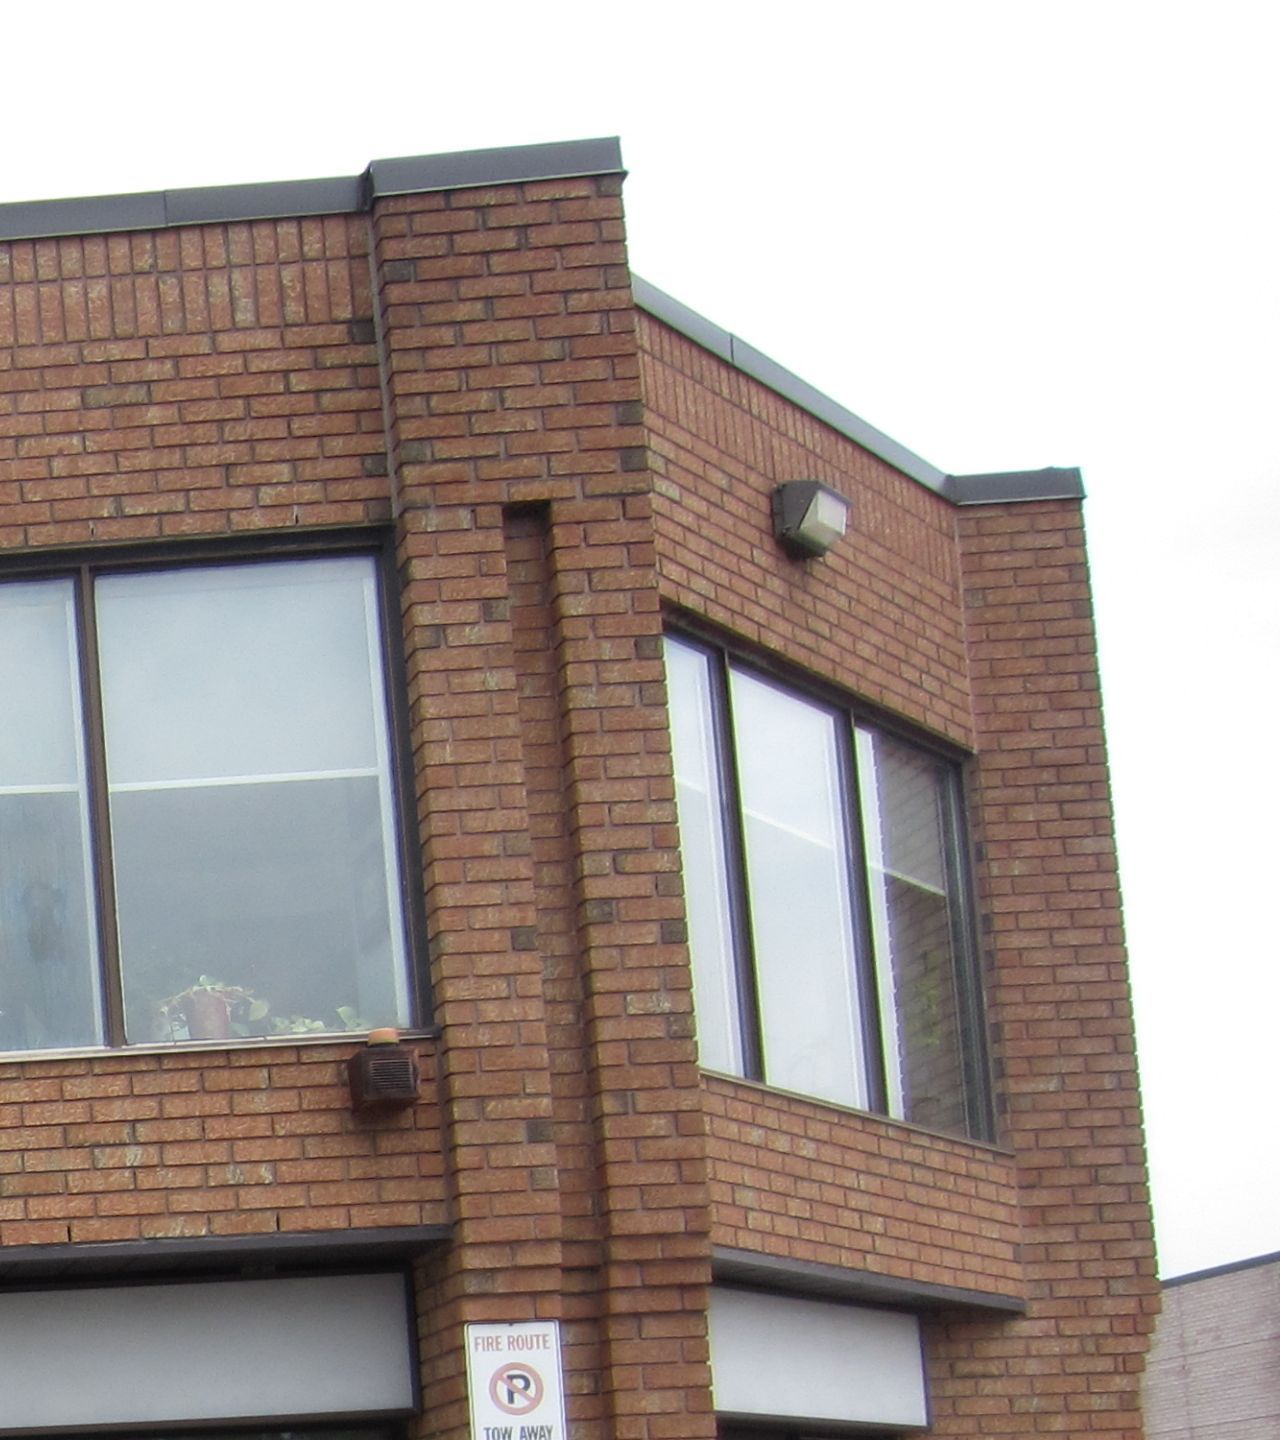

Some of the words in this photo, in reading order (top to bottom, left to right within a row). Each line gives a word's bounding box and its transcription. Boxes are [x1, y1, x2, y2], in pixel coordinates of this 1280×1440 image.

[474, 1335, 502, 1352] FIRE
[508, 1333, 550, 1350] ROUTE
[519, 1425, 553, 1440] AWAY
